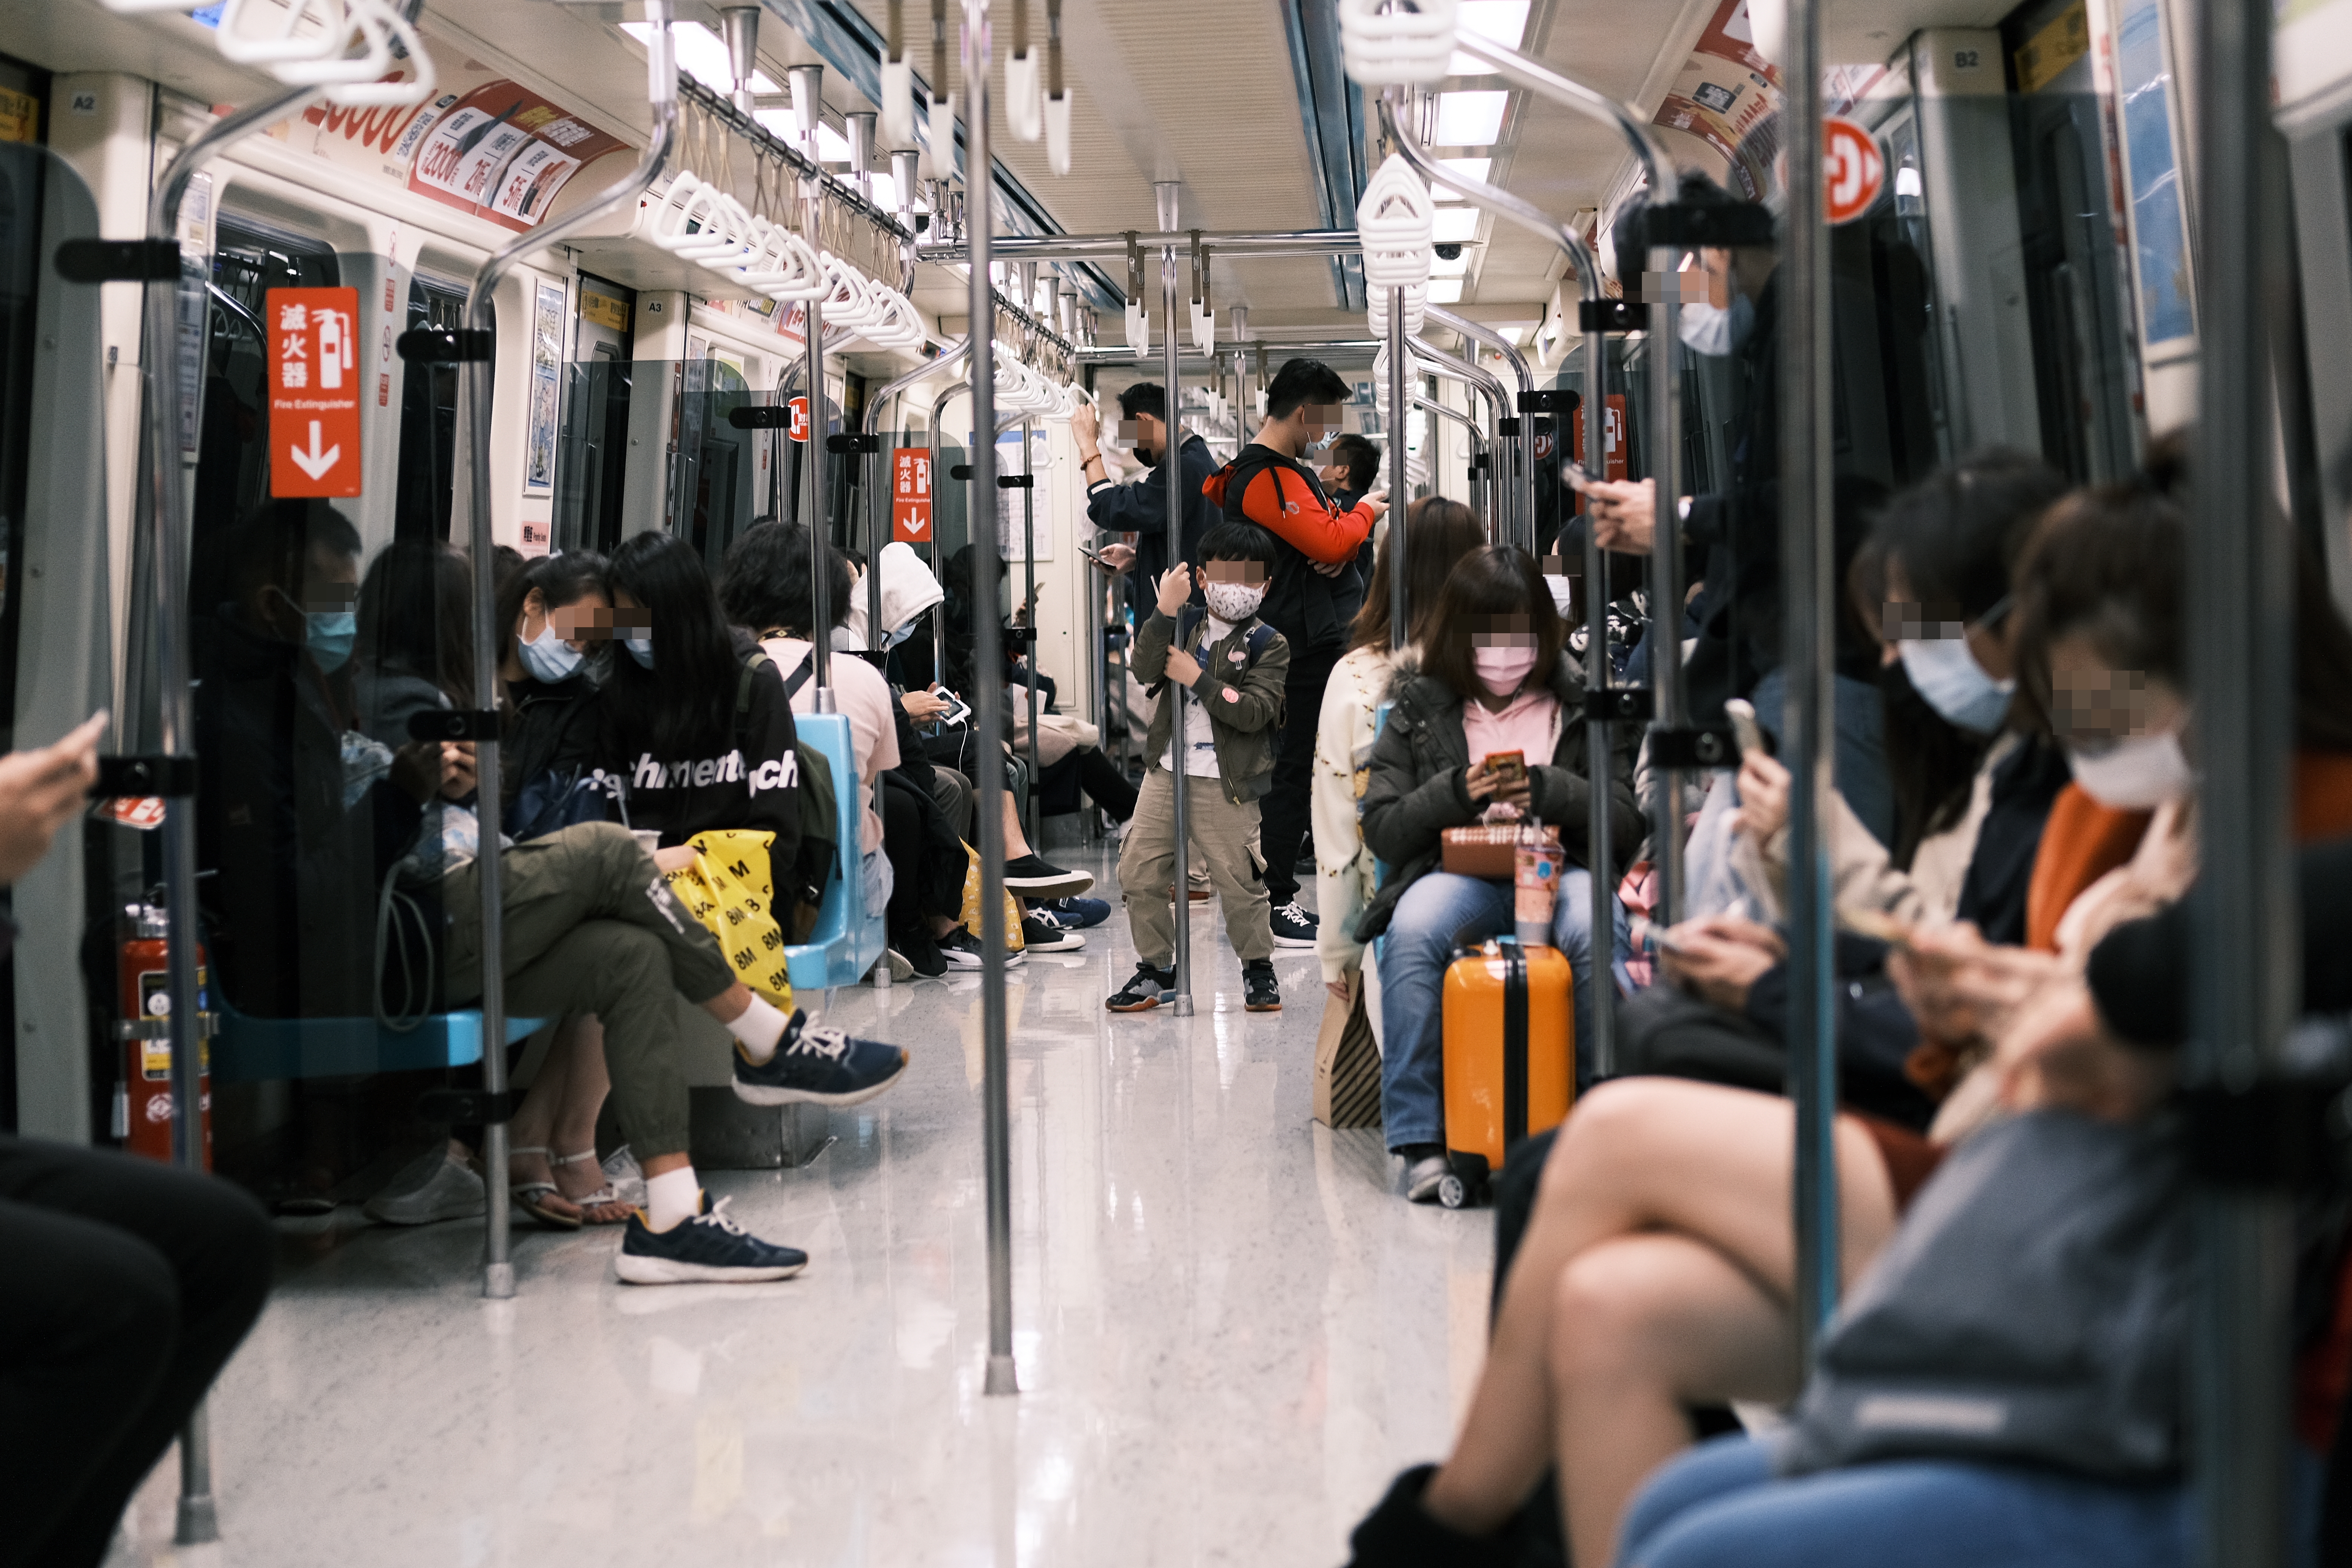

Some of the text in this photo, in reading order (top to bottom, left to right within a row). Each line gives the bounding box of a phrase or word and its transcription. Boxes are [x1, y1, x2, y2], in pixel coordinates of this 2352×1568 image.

[1955, 51, 1978, 67] B2
[74, 96, 94, 109] A2
[649, 302, 662, 312] A3
[280, 304, 308, 388] 滅火器
[274, 399, 355, 410] Fire Extinguisher
[899, 455, 911, 493] 滅火器
[762, 928, 782, 950] 8M
[734, 947, 757, 970] 8M
[769, 968, 788, 991] 8M
